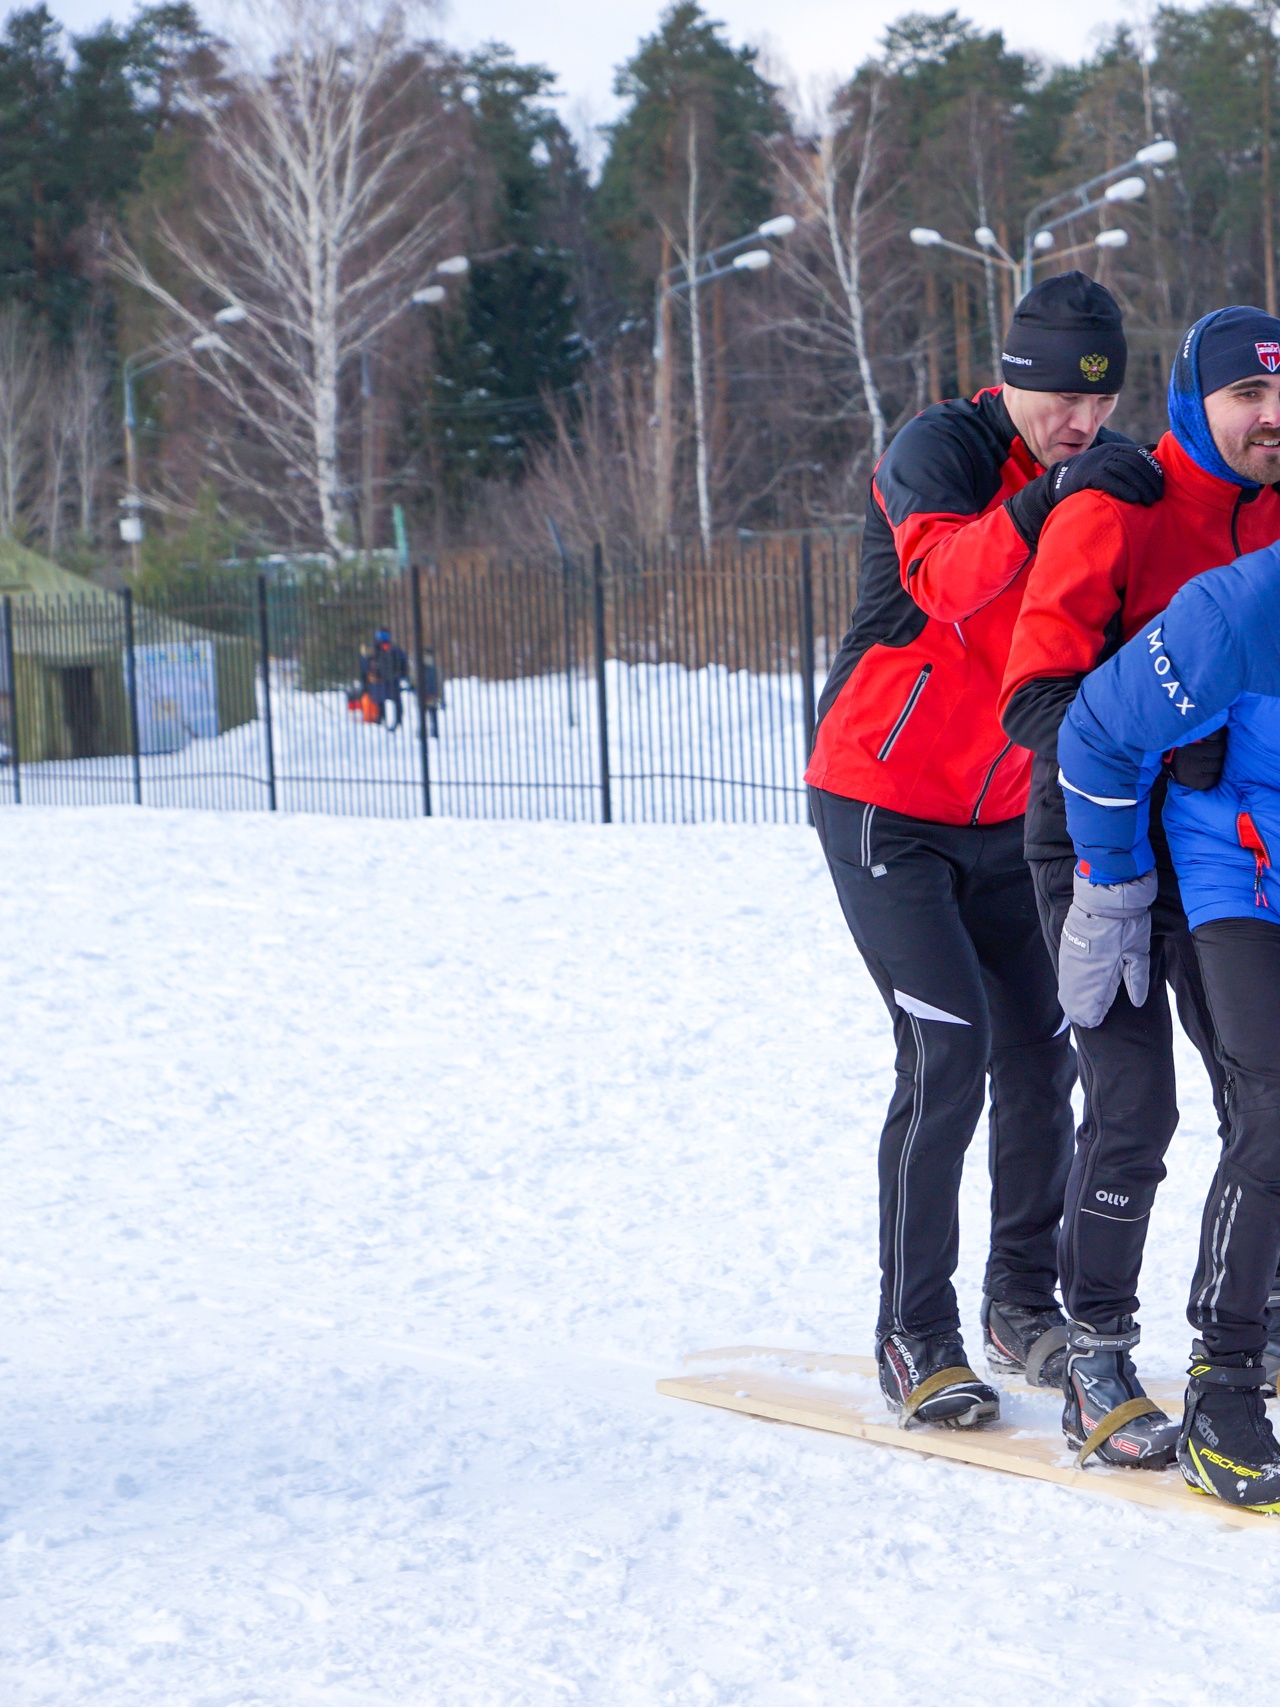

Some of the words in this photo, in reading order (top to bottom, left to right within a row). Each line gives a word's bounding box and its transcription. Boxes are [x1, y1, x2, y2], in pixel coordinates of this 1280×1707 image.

[1146, 627, 1196, 716] MOAX
[1095, 1190, 1129, 1207] OLLY
[1083, 1335, 1140, 1347] SPINE
[1199, 1447, 1262, 1479] FISCHER
